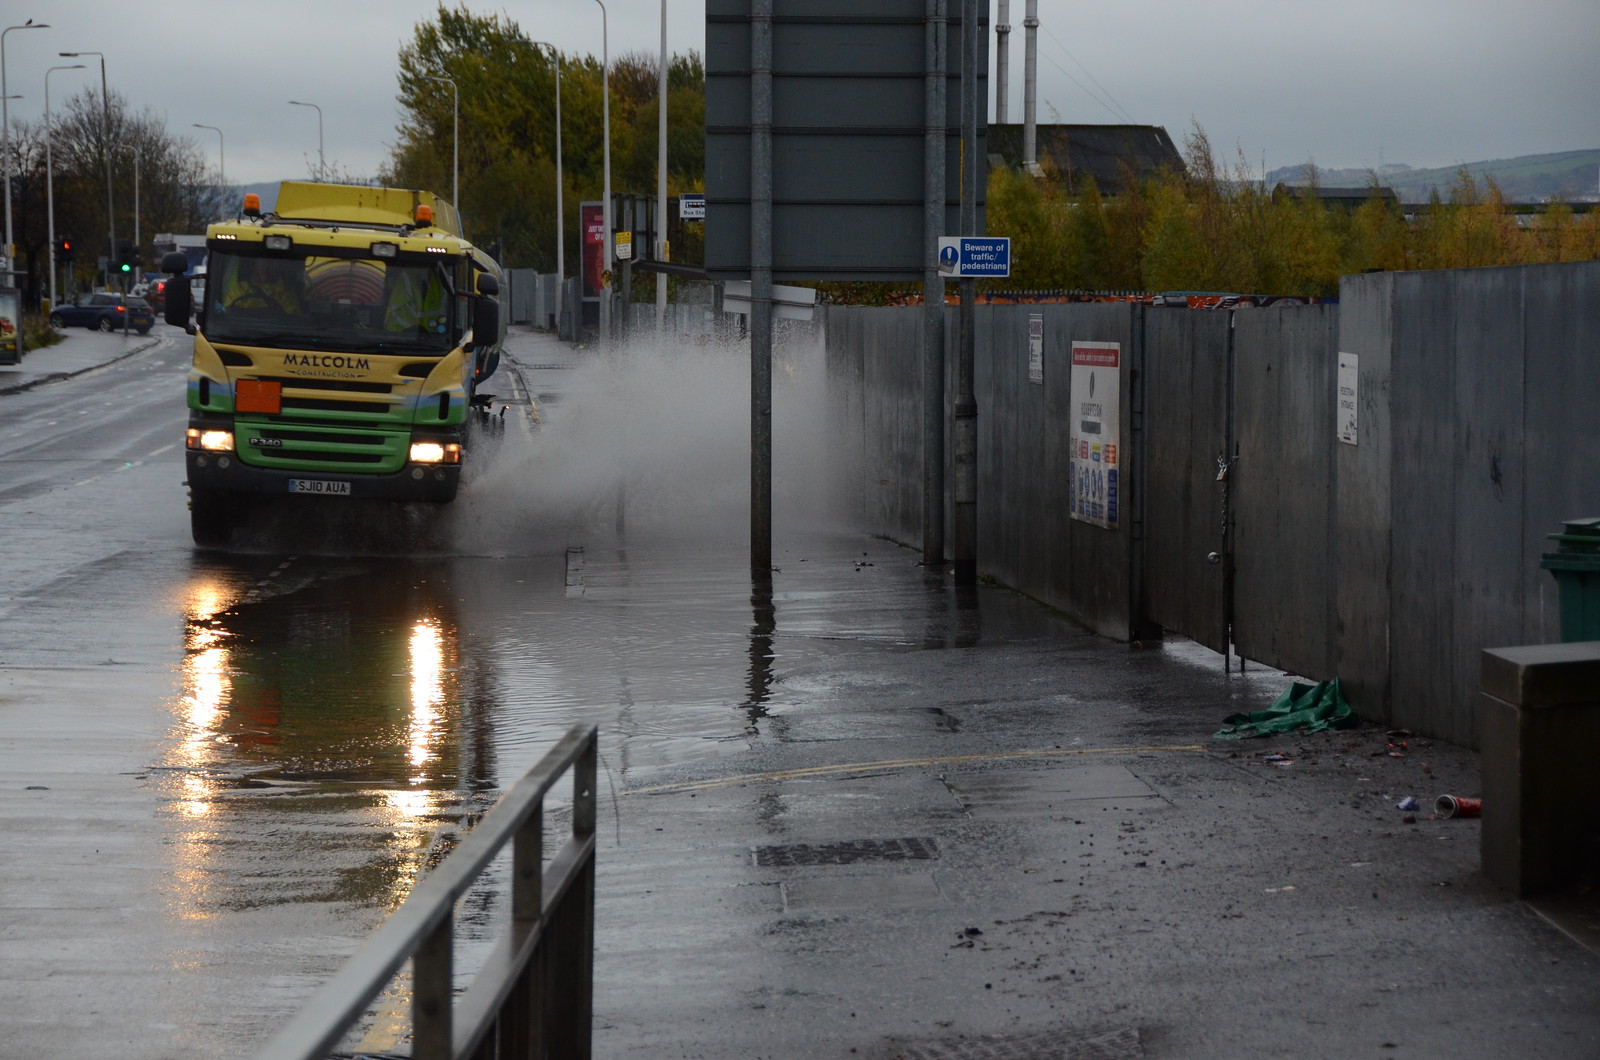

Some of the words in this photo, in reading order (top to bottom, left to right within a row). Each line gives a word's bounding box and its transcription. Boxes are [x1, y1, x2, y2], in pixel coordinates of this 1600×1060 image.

[964, 243, 993, 252] Beware
[996, 243, 1004, 252] of
[971, 252, 998, 261] traffic/
[961, 262, 1007, 271] pedestrians
[283, 353, 370, 370] MALCOLM
[296, 370, 356, 378] CONSTRUCTION
[298, 480, 323, 492] SJ10
[325, 482, 346, 493] AUA
